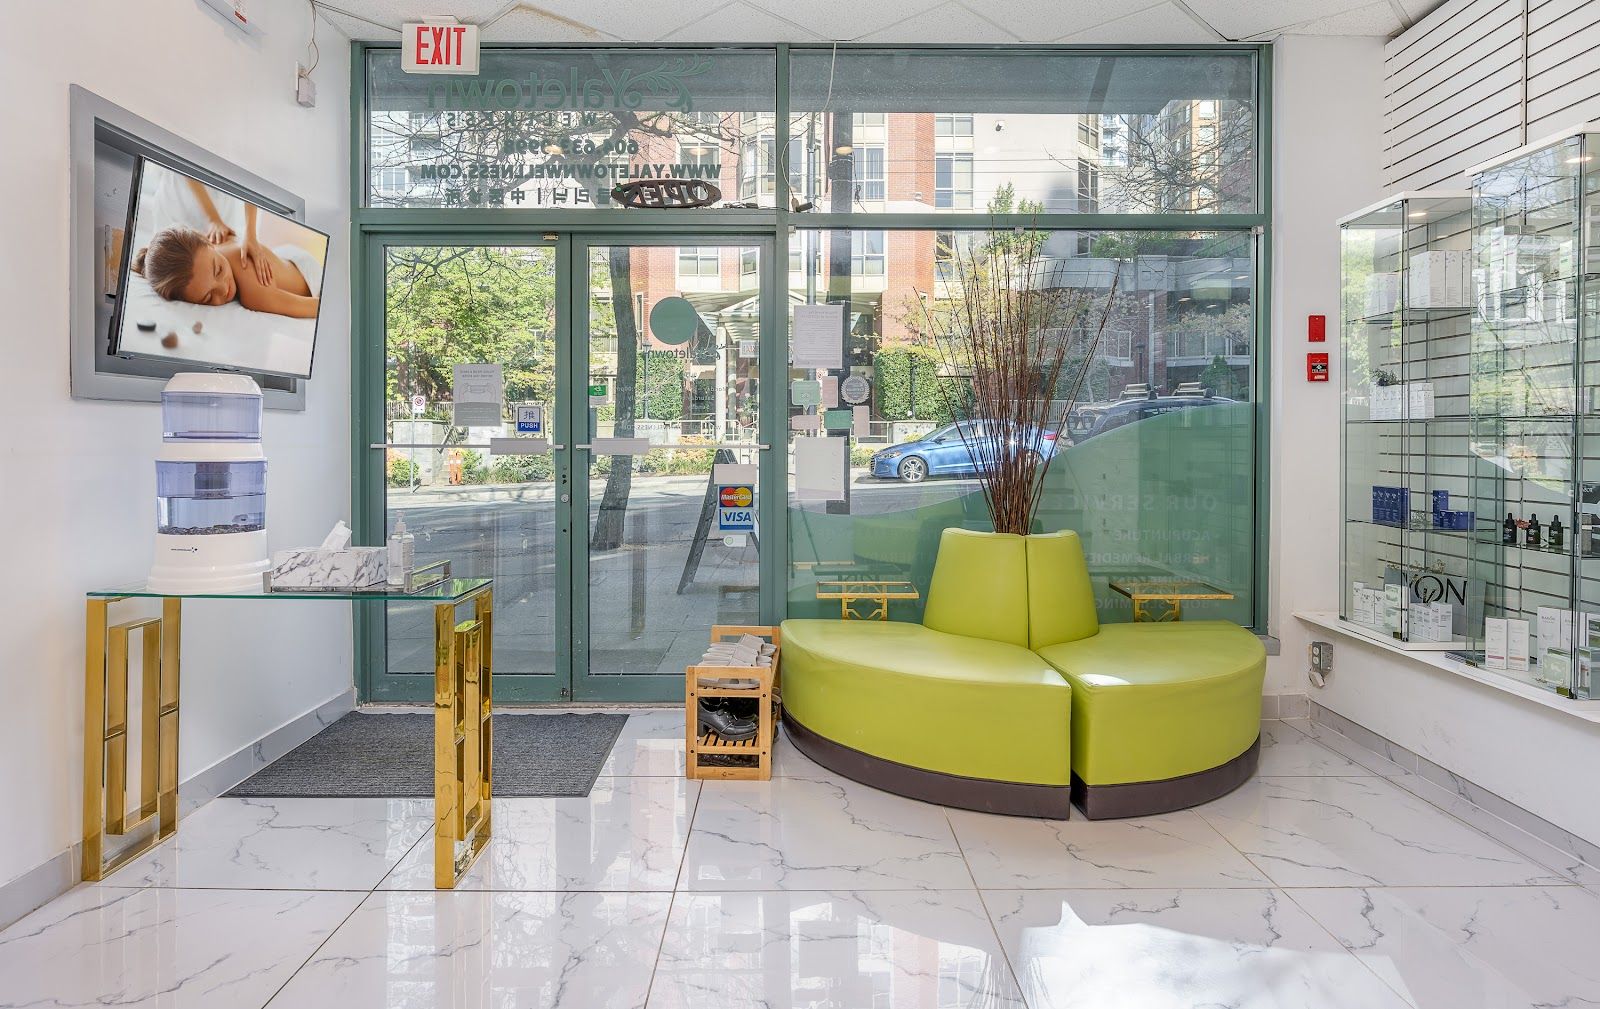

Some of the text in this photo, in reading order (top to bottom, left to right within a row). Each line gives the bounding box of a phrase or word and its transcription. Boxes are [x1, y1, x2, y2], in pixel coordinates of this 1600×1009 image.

[415, 26, 466, 66] EXIT
[720, 493, 752, 501] MasterCard
[722, 511, 752, 522] VISA
